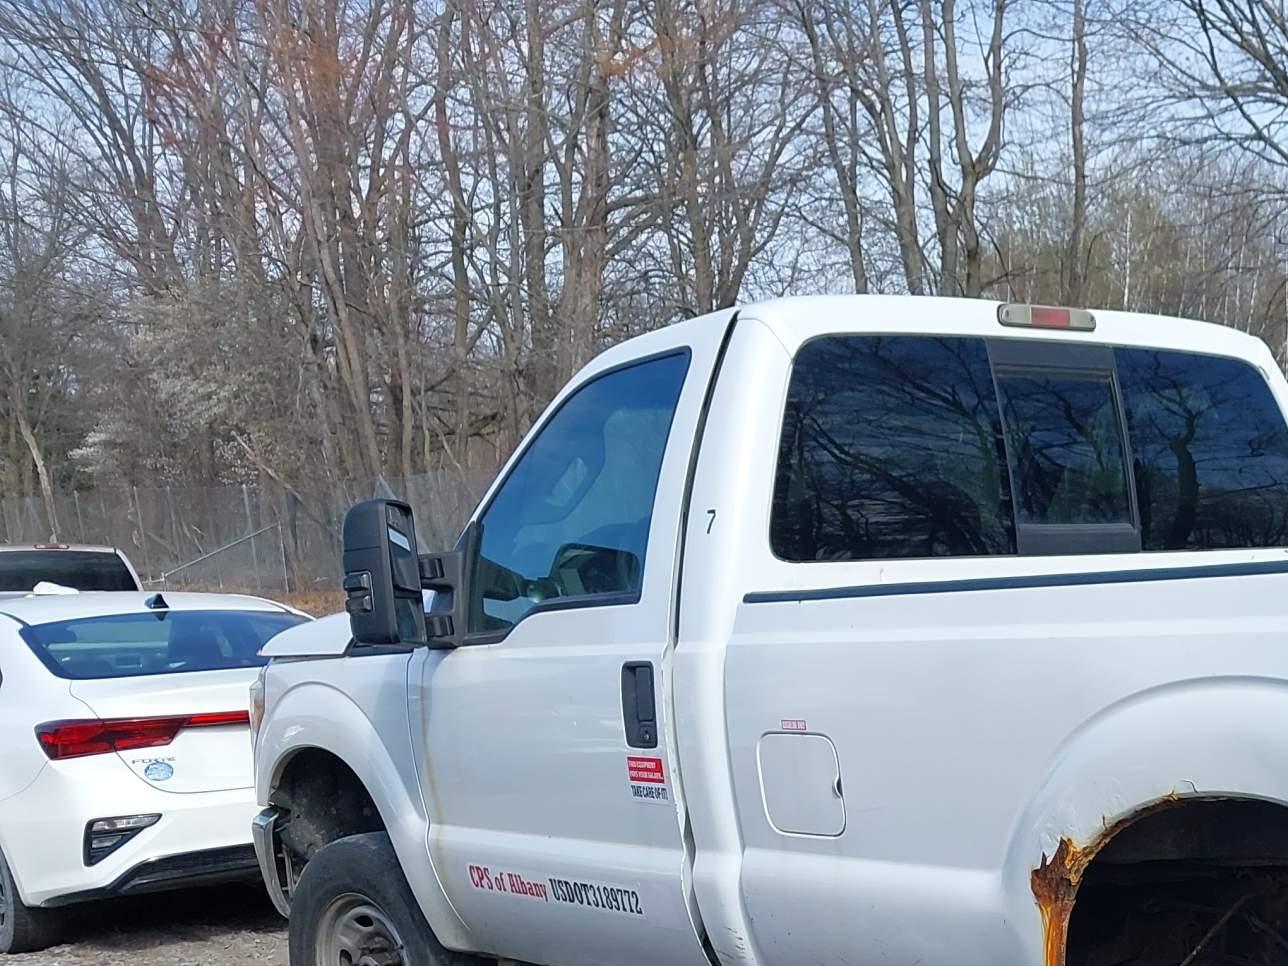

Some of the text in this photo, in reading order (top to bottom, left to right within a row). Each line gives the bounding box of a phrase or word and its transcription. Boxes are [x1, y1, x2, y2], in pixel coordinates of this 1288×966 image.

[706, 509, 717, 535] 7
[469, 865, 643, 915] CPS of Albany USDOT3189772
